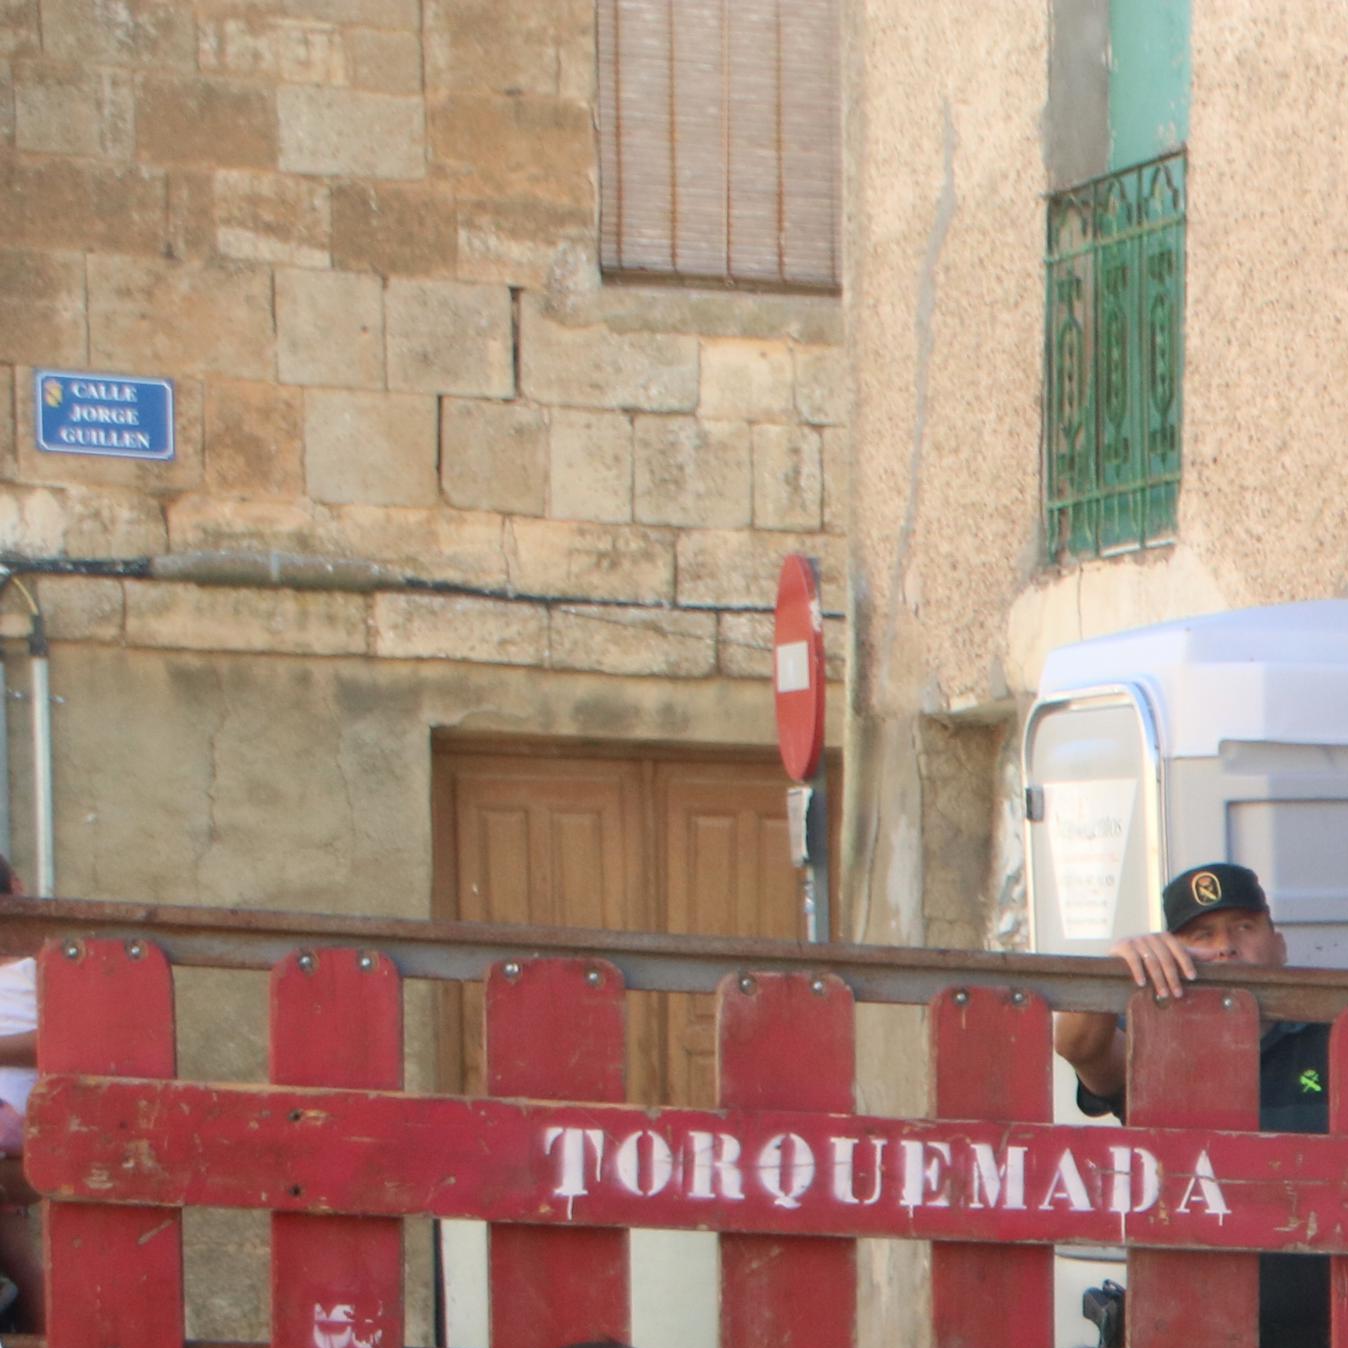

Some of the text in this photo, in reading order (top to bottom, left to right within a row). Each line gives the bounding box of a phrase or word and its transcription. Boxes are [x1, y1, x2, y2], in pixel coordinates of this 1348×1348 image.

[71, 381, 138, 403] CALLE
[70, 403, 140, 426] JORGE
[59, 425, 151, 450] GUILLEN
[545, 1127, 1232, 1214] TORQUEMADA
